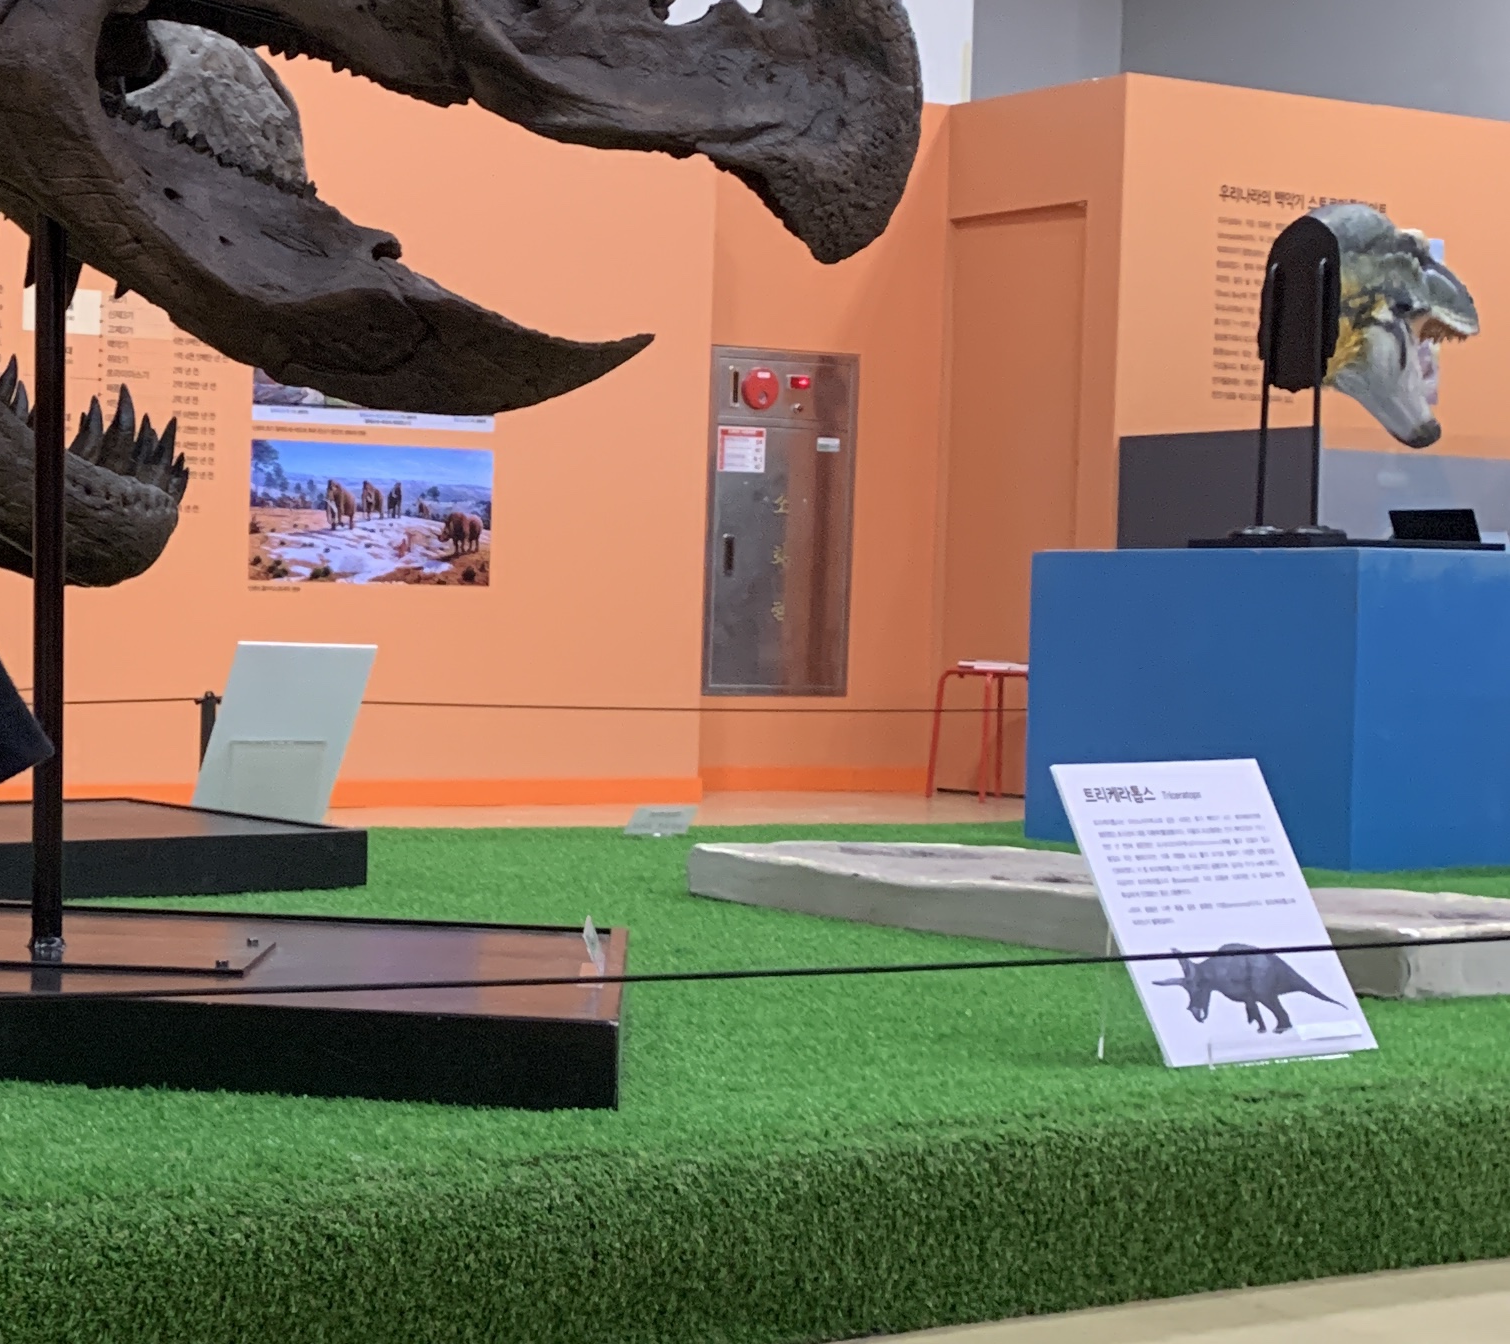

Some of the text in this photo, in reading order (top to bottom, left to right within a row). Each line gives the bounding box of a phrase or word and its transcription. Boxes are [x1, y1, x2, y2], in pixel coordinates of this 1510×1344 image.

[1218, 184, 1272, 206] 우리나라의
[1275, 191, 1305, 210] 백악기
[1083, 785, 1157, 804] 트리케라톱스
